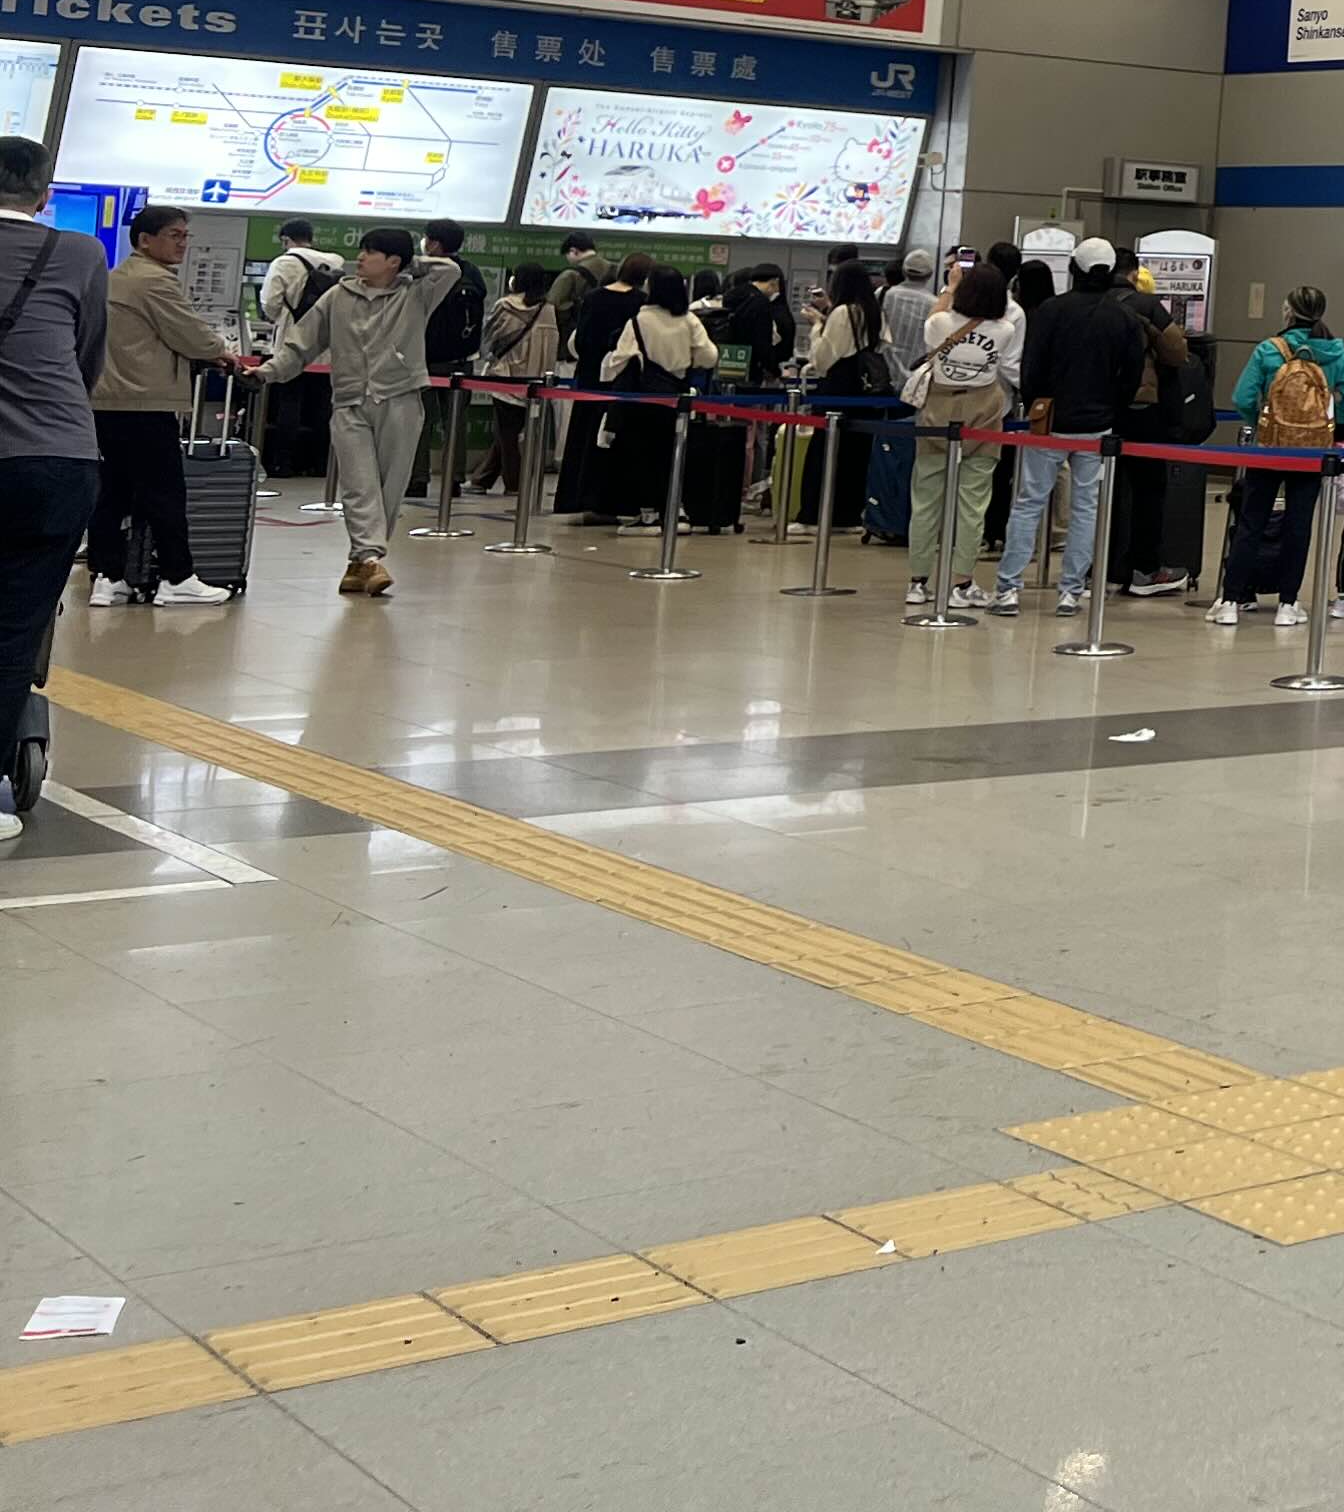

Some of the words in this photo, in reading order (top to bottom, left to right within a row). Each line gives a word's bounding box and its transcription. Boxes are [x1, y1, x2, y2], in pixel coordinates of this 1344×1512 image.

[293, 9, 444, 52] 표사는곳
[1296, 8, 1329, 25] Sanyo
[491, 29, 607, 68] 售票处
[650, 45, 758, 81] 售票處
[871, 63, 916, 90] JR
[592, 114, 648, 137] Hello
[652, 119, 711, 146] Kitty
[588, 139, 701, 164] HARUKA
